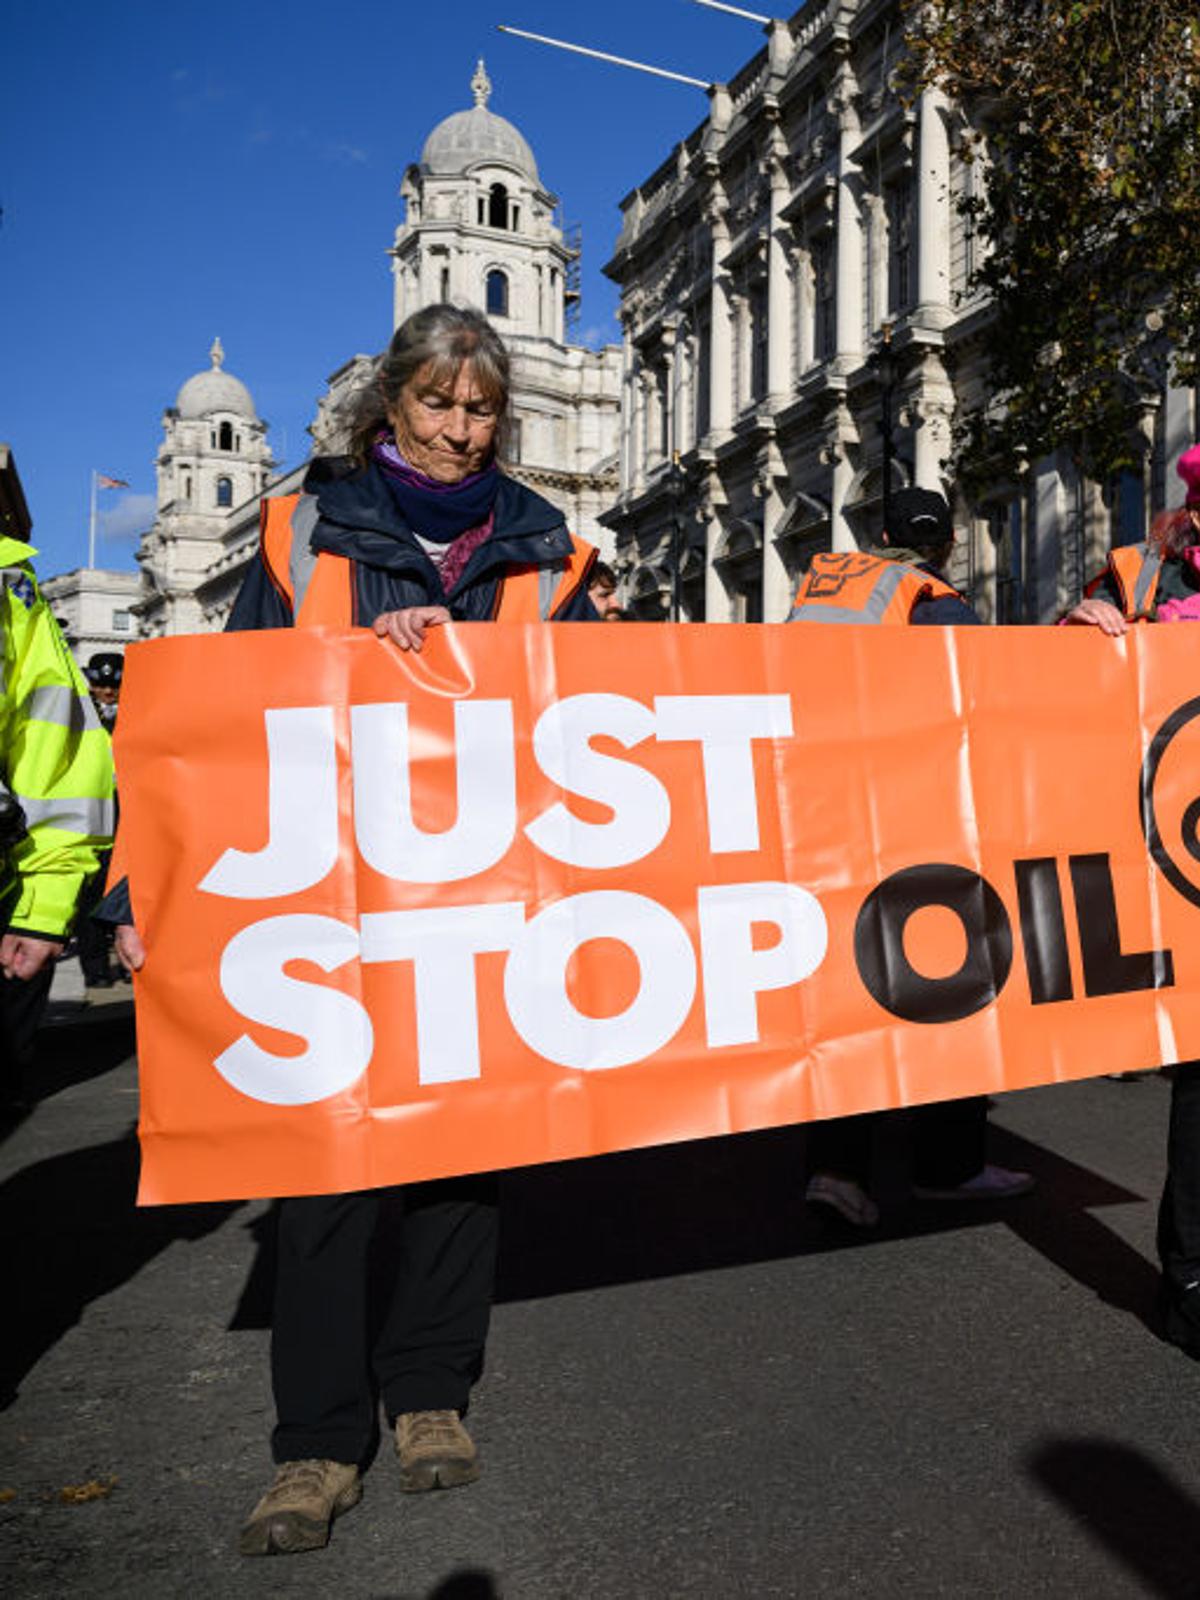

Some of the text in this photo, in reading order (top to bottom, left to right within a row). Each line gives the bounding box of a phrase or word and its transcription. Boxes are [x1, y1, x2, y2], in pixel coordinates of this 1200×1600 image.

[198, 693, 794, 900] JUST
[214, 852, 1174, 1105] STOP OIL
